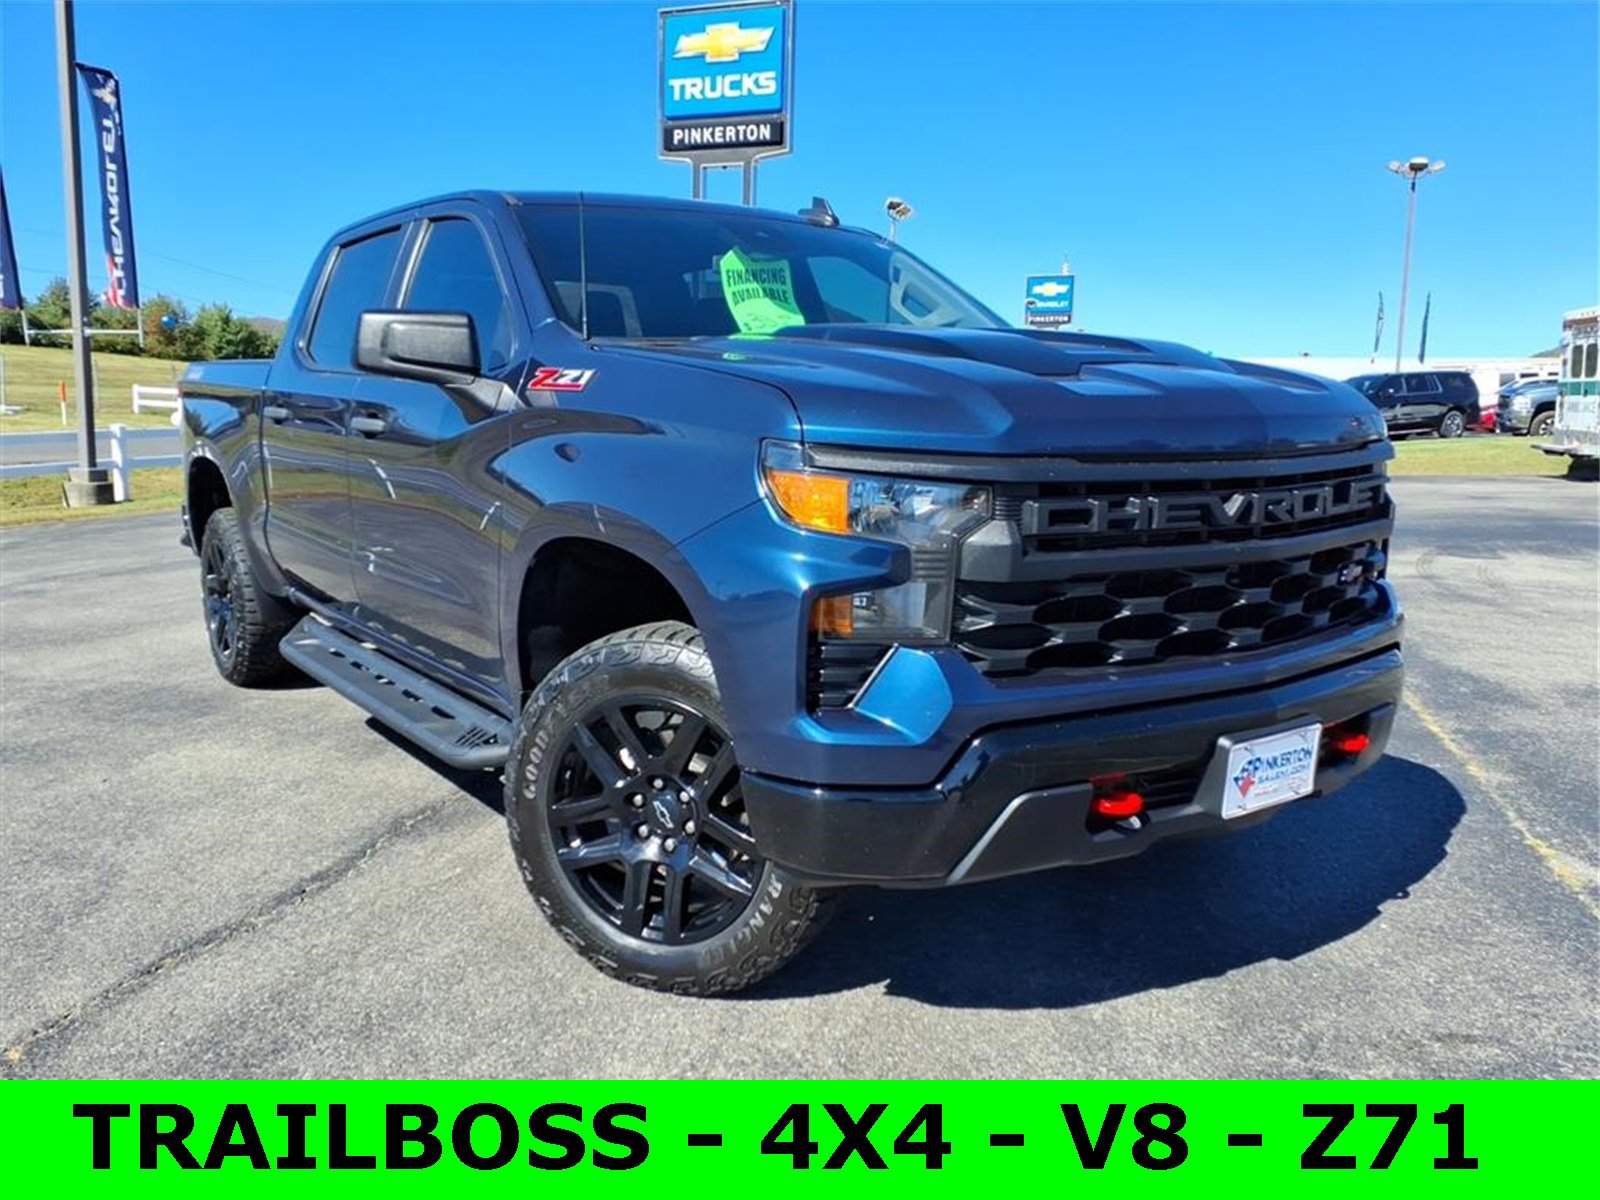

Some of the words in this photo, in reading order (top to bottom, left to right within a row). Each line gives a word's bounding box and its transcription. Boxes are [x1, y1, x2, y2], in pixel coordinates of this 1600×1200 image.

[668, 71, 777, 101] TRUCKS
[673, 124, 771, 145] PINKERTON
[726, 266, 787, 288] FINANCING
[731, 285, 789, 308] AVAILABLE
[528, 367, 597, 392] Z71
[1252, 746, 1312, 776] PINKERTON
